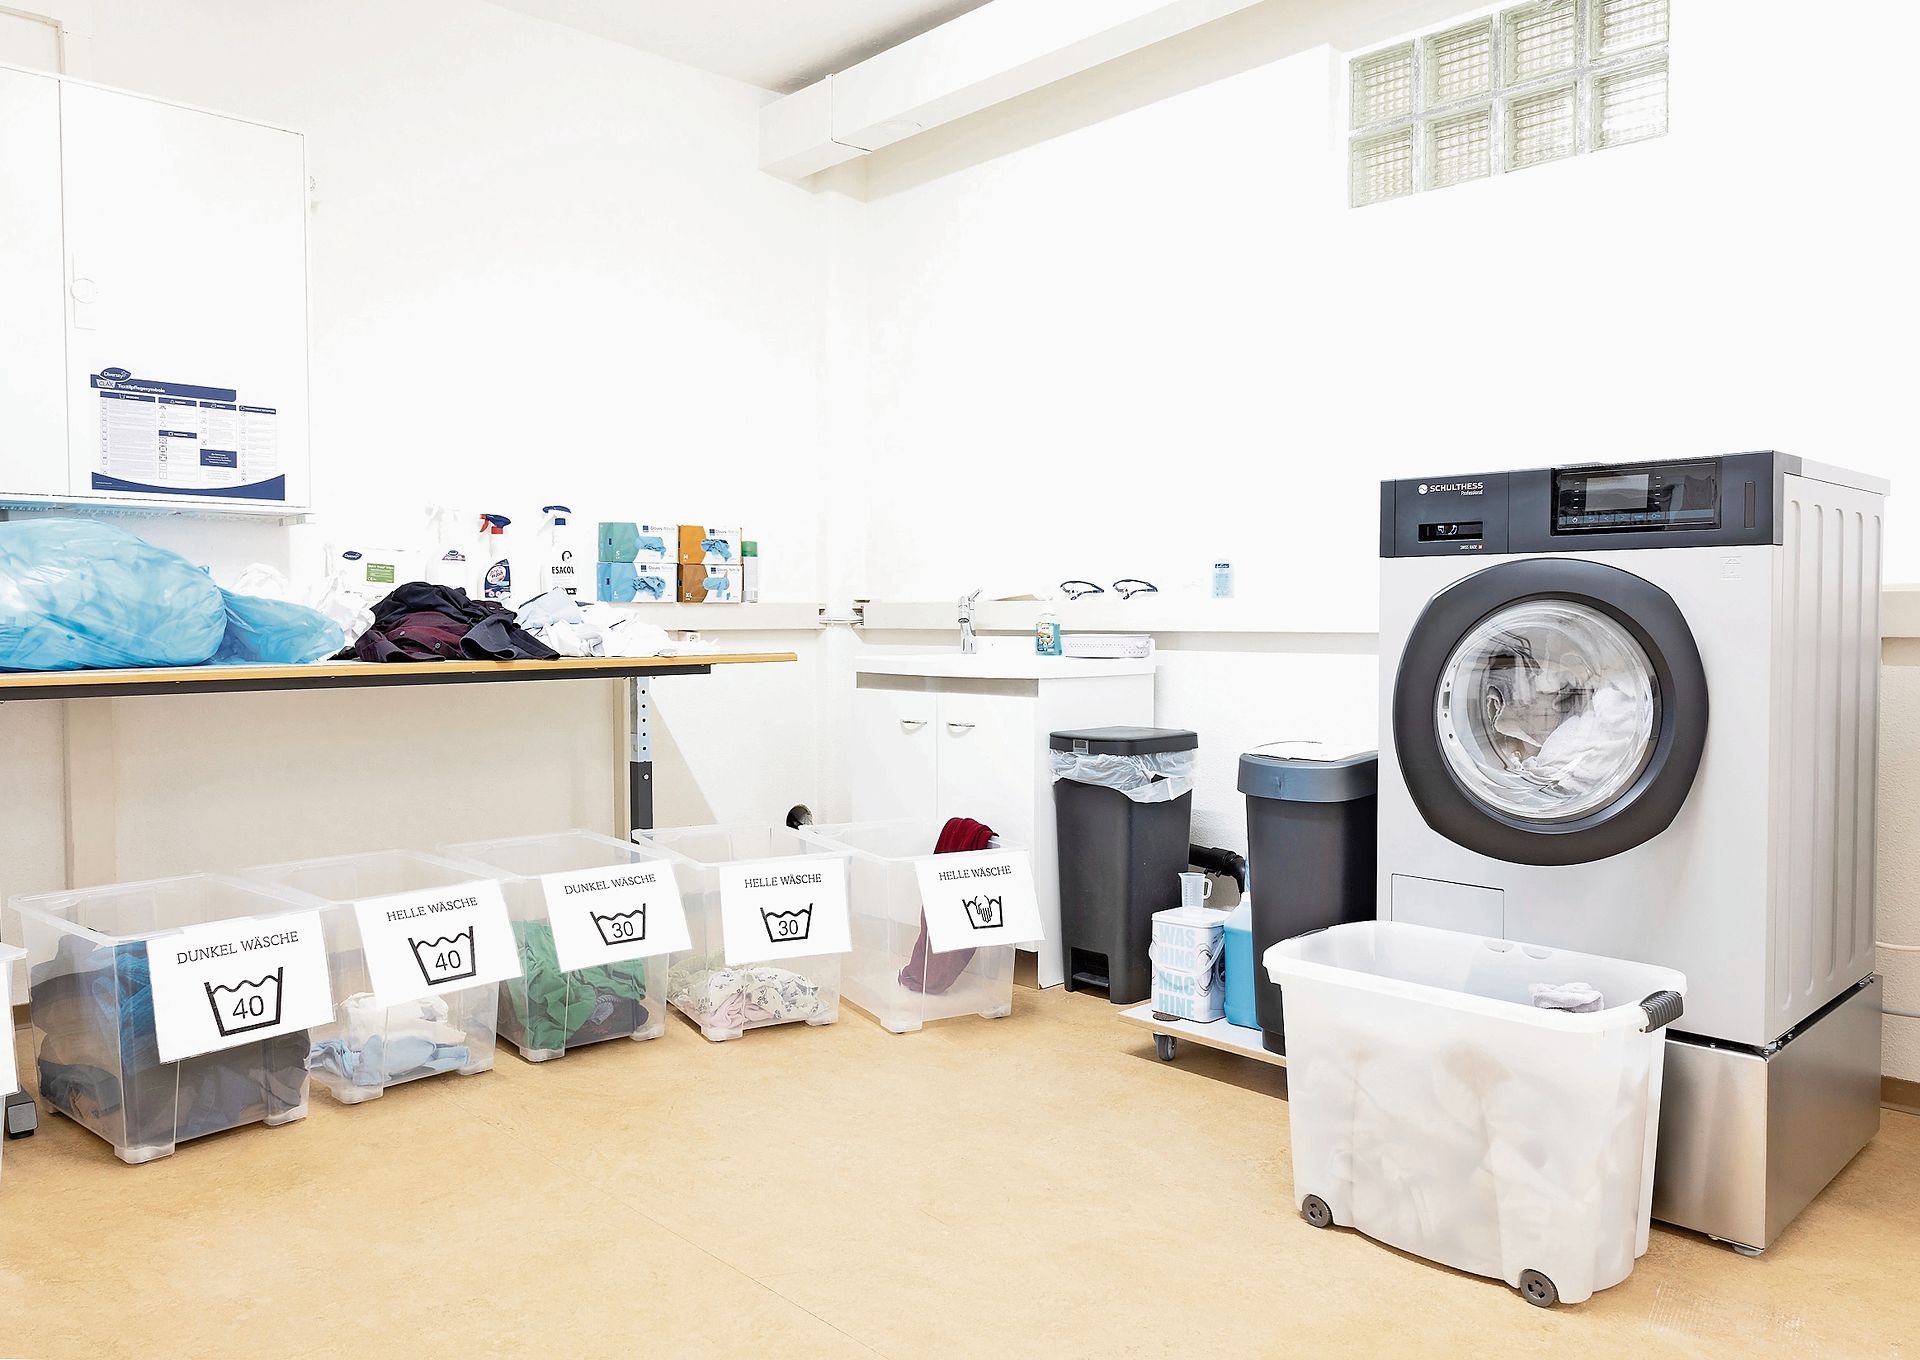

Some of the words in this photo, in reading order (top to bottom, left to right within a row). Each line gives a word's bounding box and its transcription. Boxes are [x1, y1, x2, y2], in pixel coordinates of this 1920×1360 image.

[1429, 482, 1484, 493] SCHULTHESS
[551, 566, 575, 575] ESACOL
[564, 880, 610, 895] DUNKEL
[611, 873, 657, 888] WÄSCHE
[744, 876, 778, 889] HELLE
[779, 873, 822, 886] WÄSCHE
[938, 869, 971, 881] HELLE
[971, 865, 1012, 878] WÄSCHE
[386, 906, 427, 922] HELLE
[427, 896, 478, 914] WÄSCHE
[611, 920, 634, 939] 30
[777, 918, 799, 937] 30
[1159, 924, 1196, 948] WAS
[176, 942, 238, 965] DUNKEL
[240, 930, 299, 952] WÄSCHE
[435, 949, 462, 972] 40
[1158, 970, 1196, 996] MAC
[232, 994, 265, 1020] 40
[1158, 992, 1196, 1018] HINE
